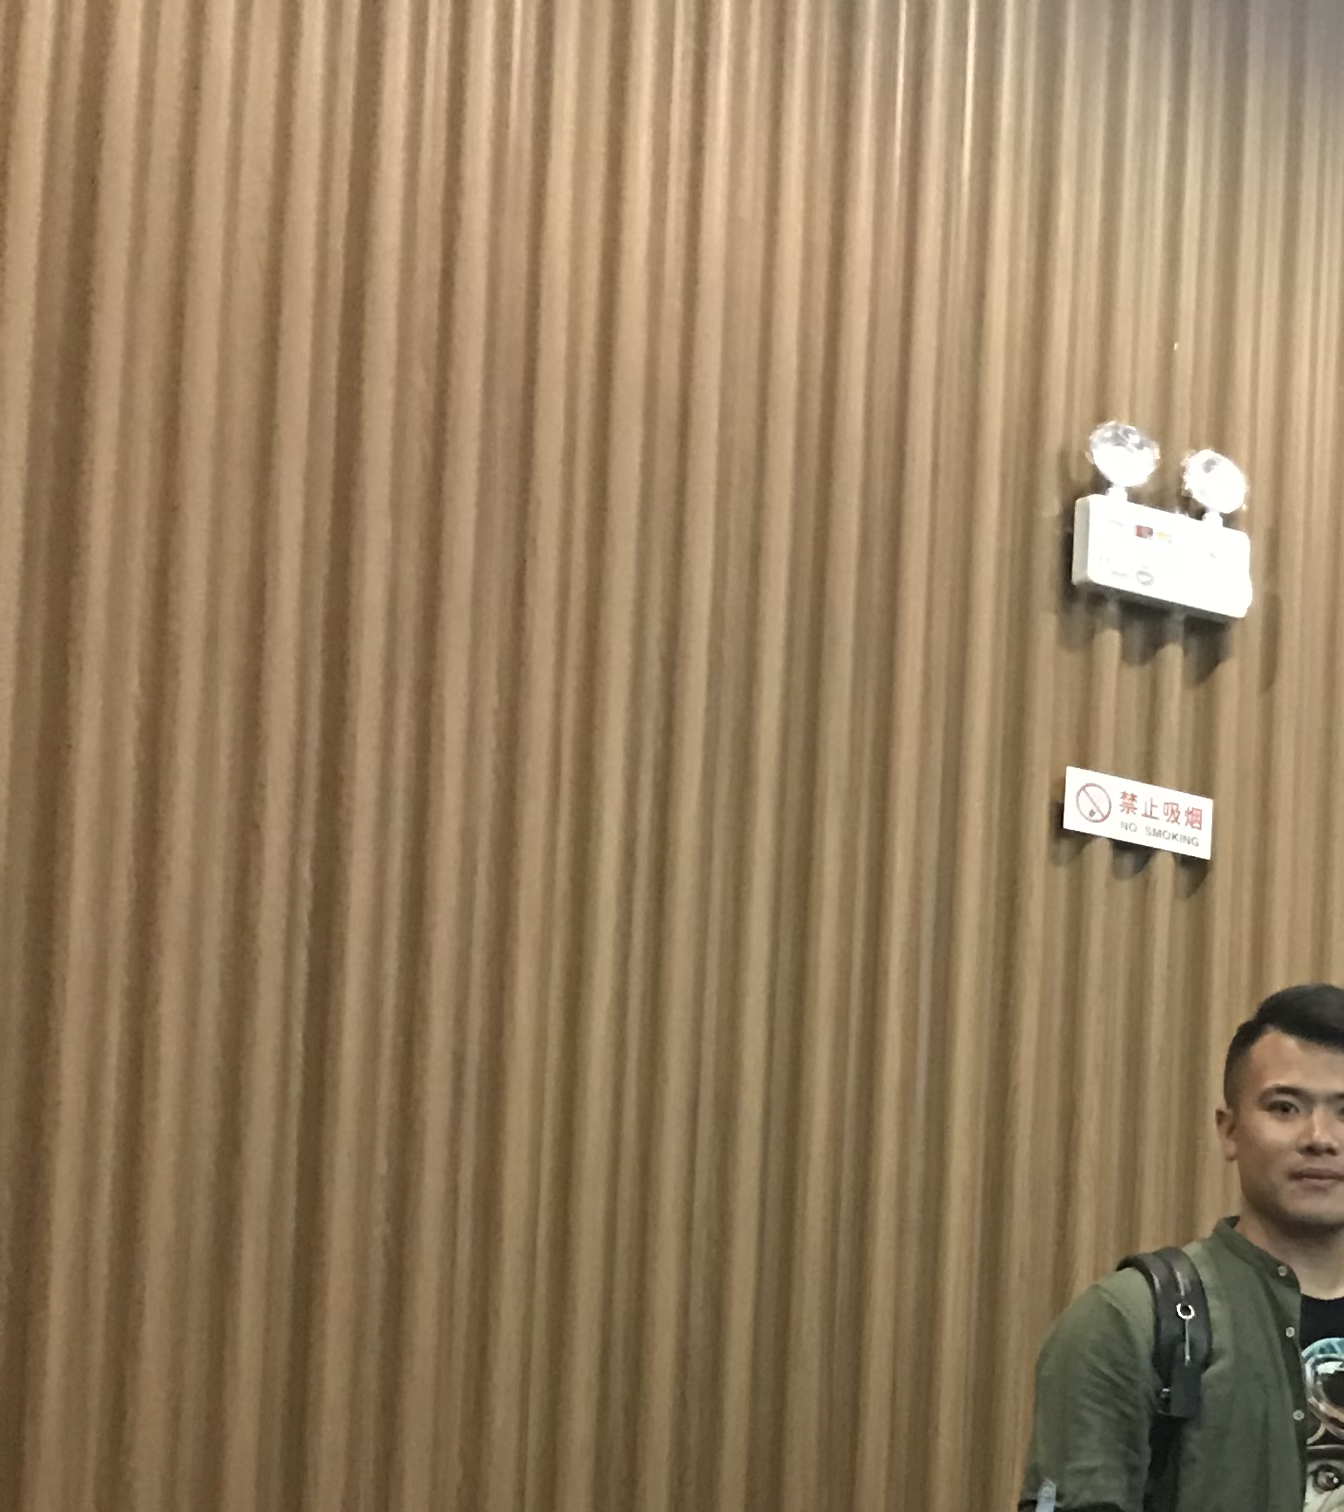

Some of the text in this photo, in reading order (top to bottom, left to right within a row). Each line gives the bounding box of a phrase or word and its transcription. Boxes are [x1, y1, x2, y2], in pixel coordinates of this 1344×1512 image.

[1119, 791, 1203, 830] 禁止吸烟
[1120, 821, 1200, 847] NO SMOKING
